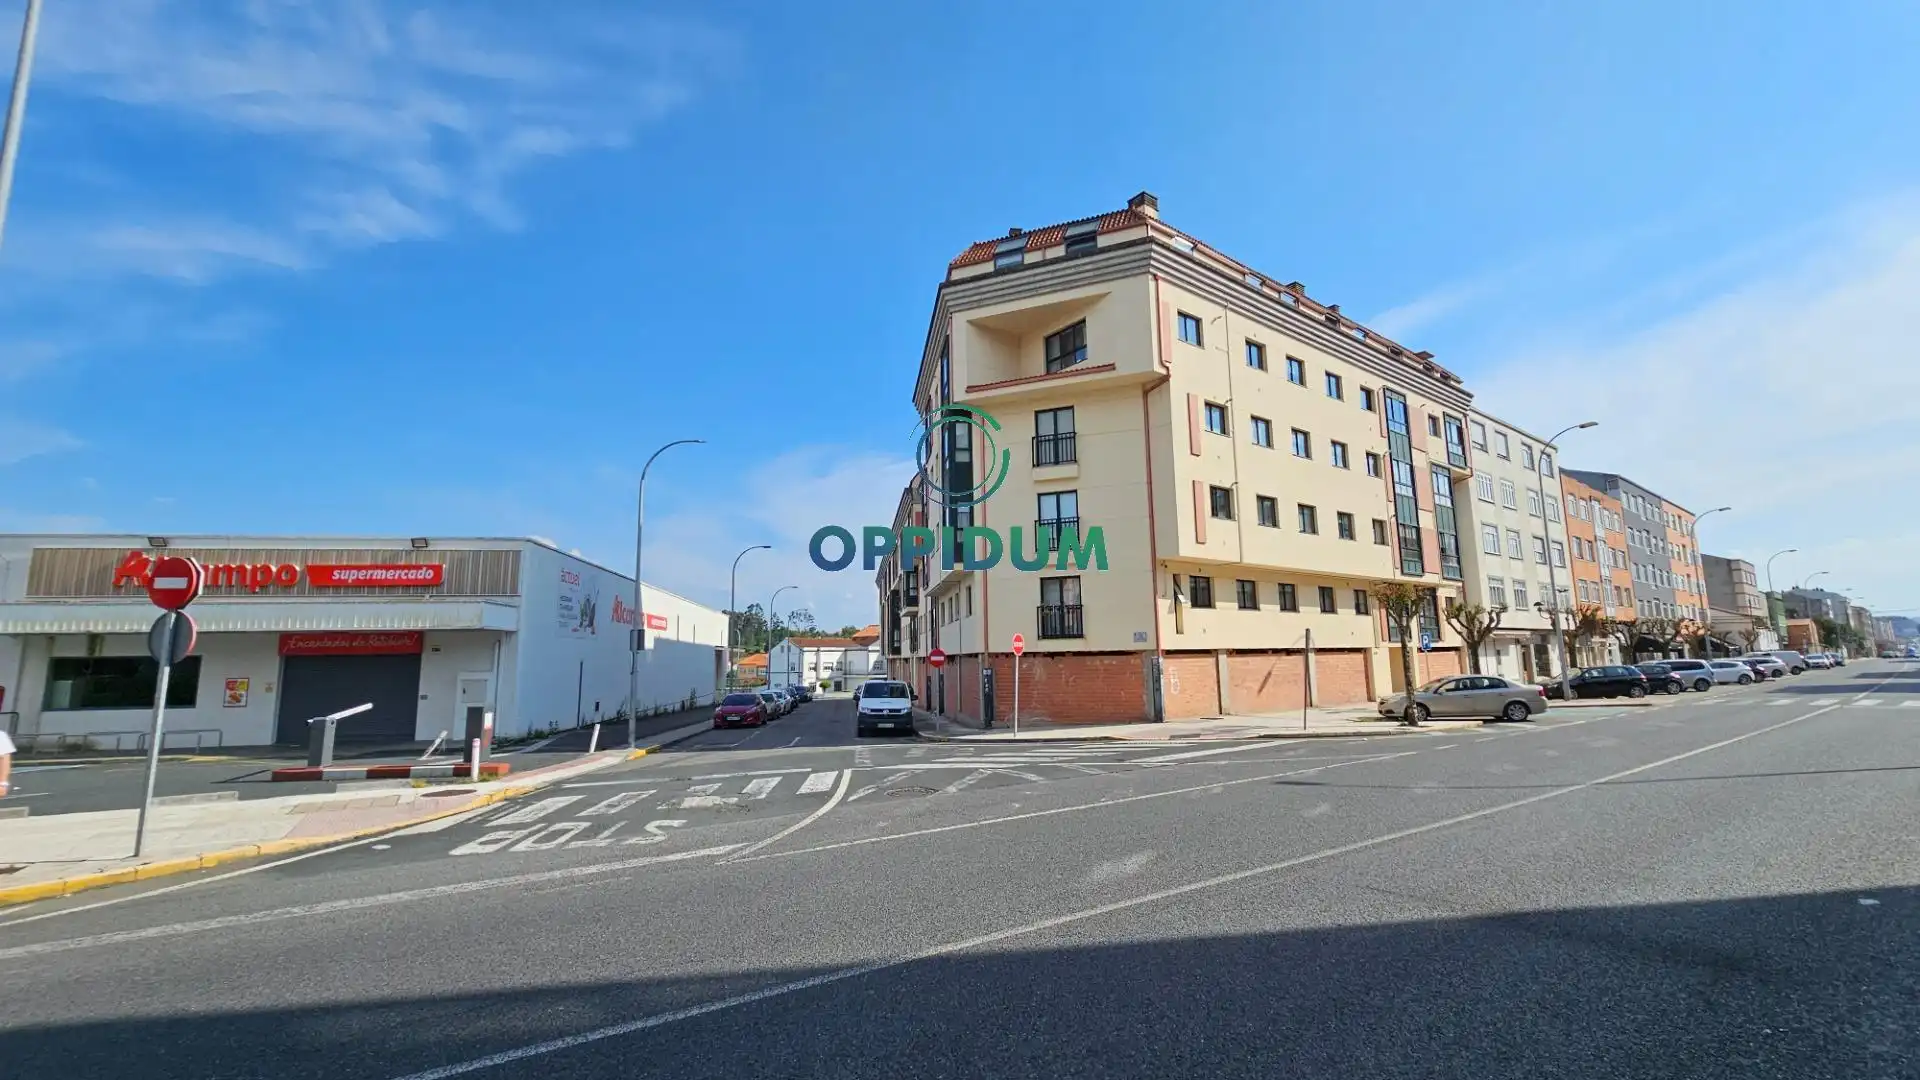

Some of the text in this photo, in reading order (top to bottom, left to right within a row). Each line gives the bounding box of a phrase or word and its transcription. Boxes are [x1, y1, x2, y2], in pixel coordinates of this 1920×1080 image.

[112, 551, 299, 593] Ampo
[331, 567, 435, 583] supermercado
[449, 820, 688, 856] STOP
